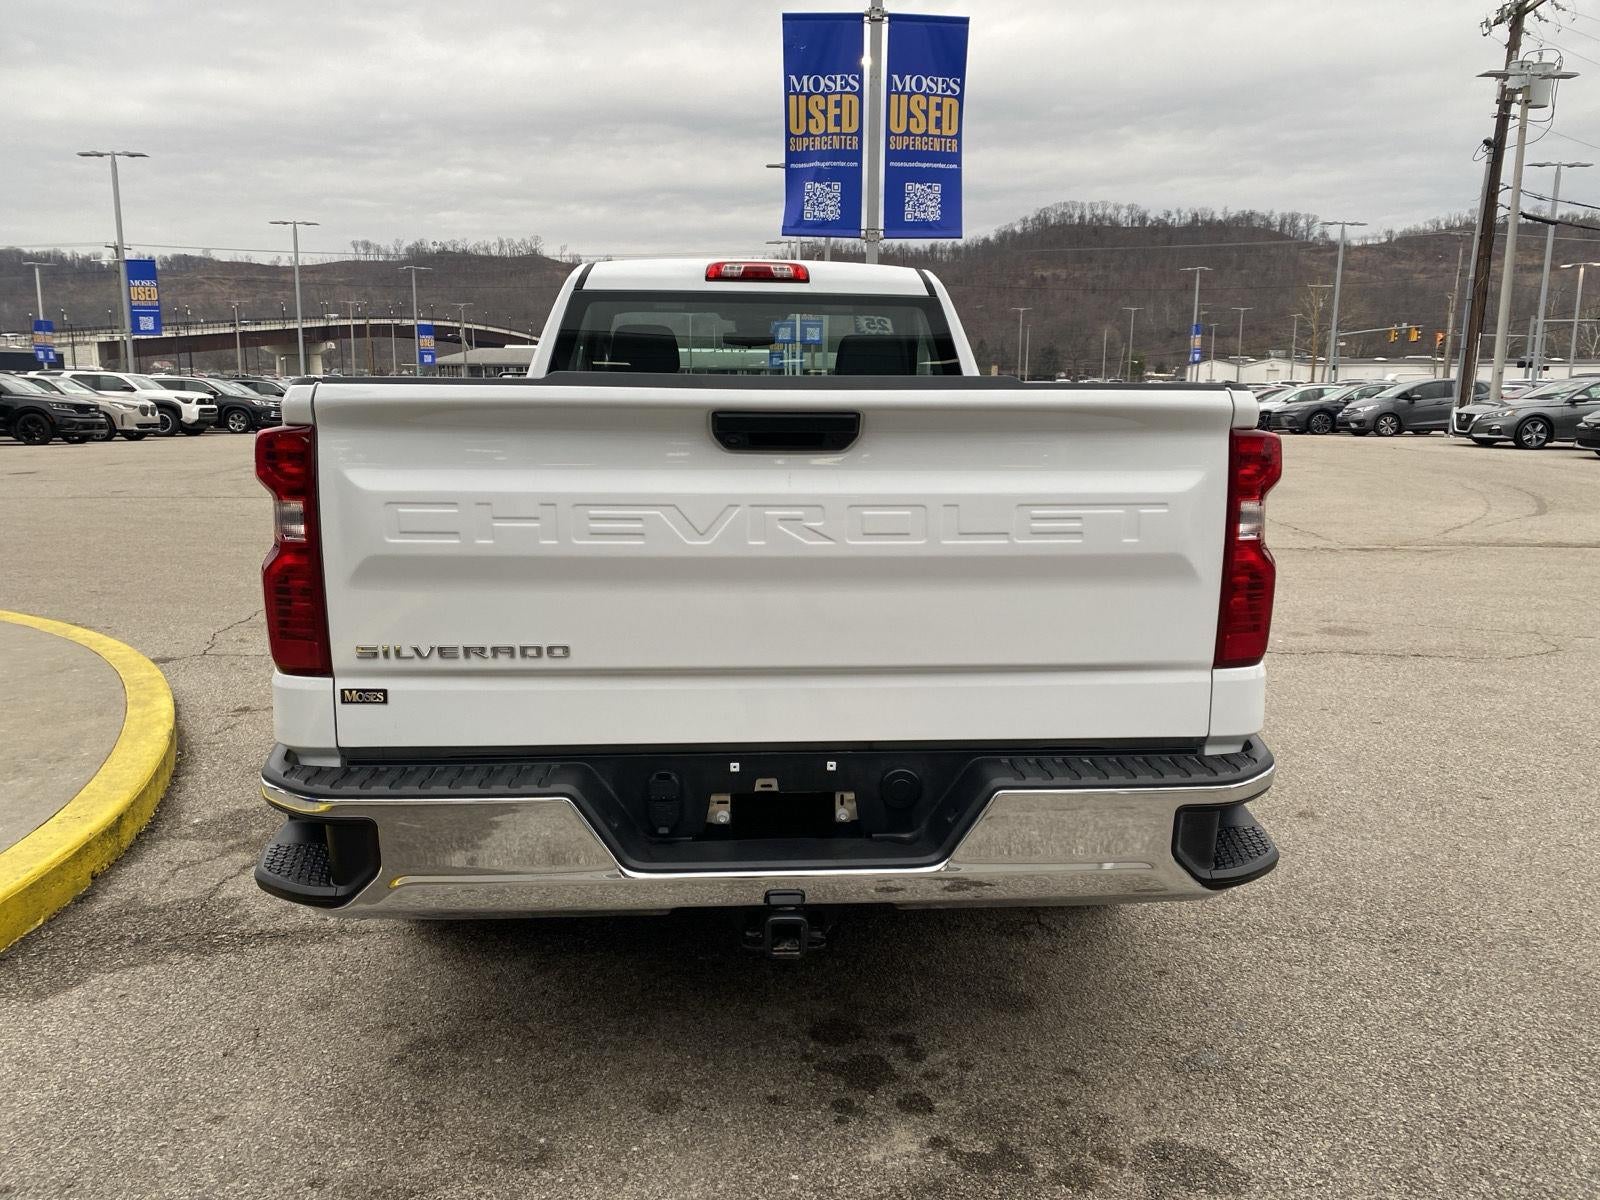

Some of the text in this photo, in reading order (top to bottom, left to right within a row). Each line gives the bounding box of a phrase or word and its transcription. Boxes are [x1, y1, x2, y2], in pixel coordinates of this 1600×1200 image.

[789, 74, 860, 93] MOSES
[891, 74, 961, 95] MOSES
[789, 94, 859, 136] USED
[890, 94, 960, 136] USED
[789, 136, 859, 152] SUPERCENTER
[890, 136, 958, 153] SUPERCENTER
[129, 279, 157, 287] MOSES
[130, 287, 159, 301] USED
[385, 501, 1169, 545] CHEVROLET
[356, 645, 570, 659] SILVERADO
[343, 690, 385, 703] MOSES
